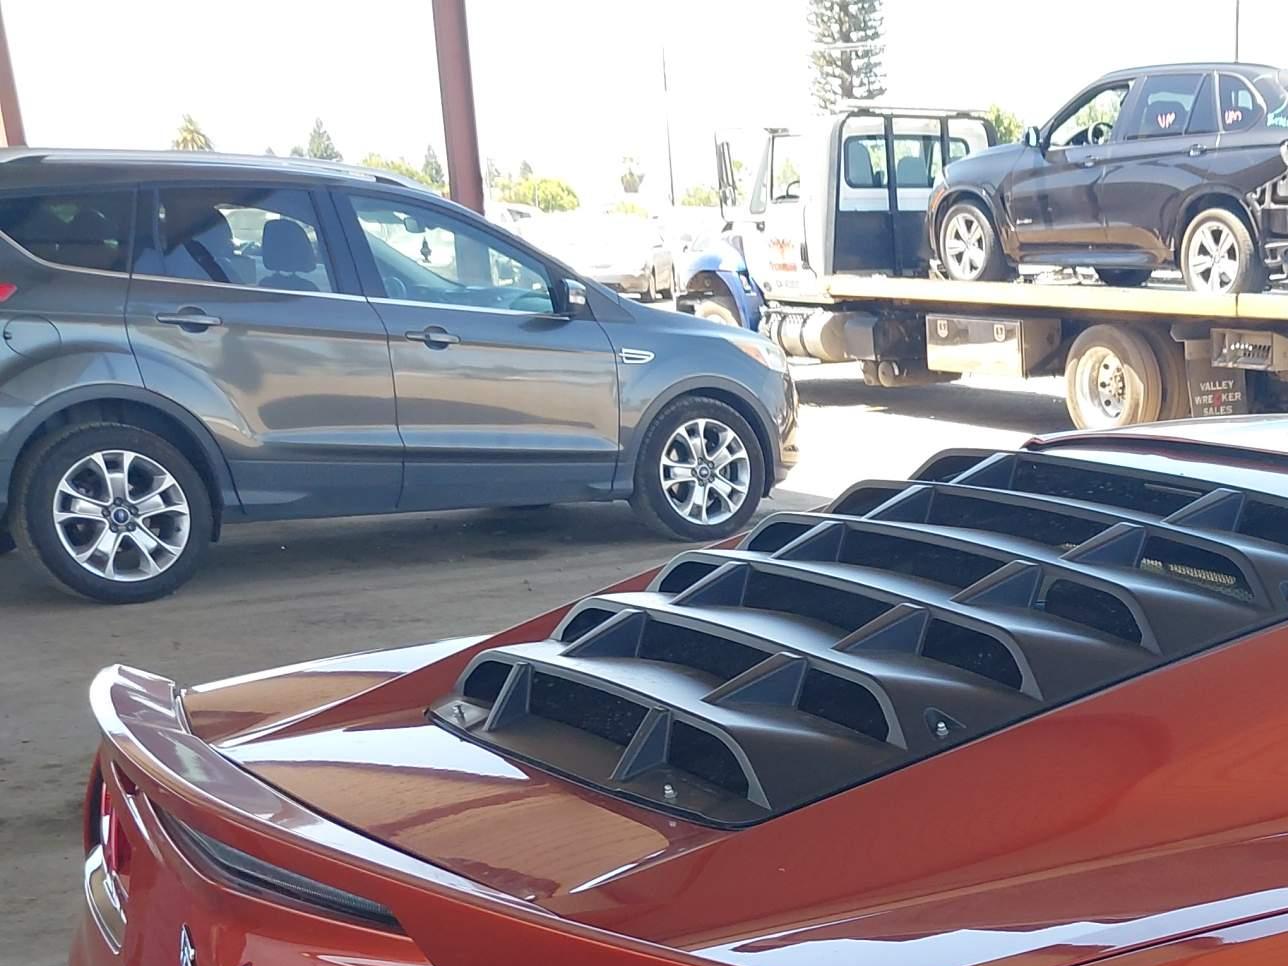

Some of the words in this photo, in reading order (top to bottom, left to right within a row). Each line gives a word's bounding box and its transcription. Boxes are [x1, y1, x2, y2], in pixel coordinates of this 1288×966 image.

[1200, 379, 1234, 391] VALLEY
[1194, 391, 1242, 405] WREKER
[1203, 405, 1233, 416] SALES
